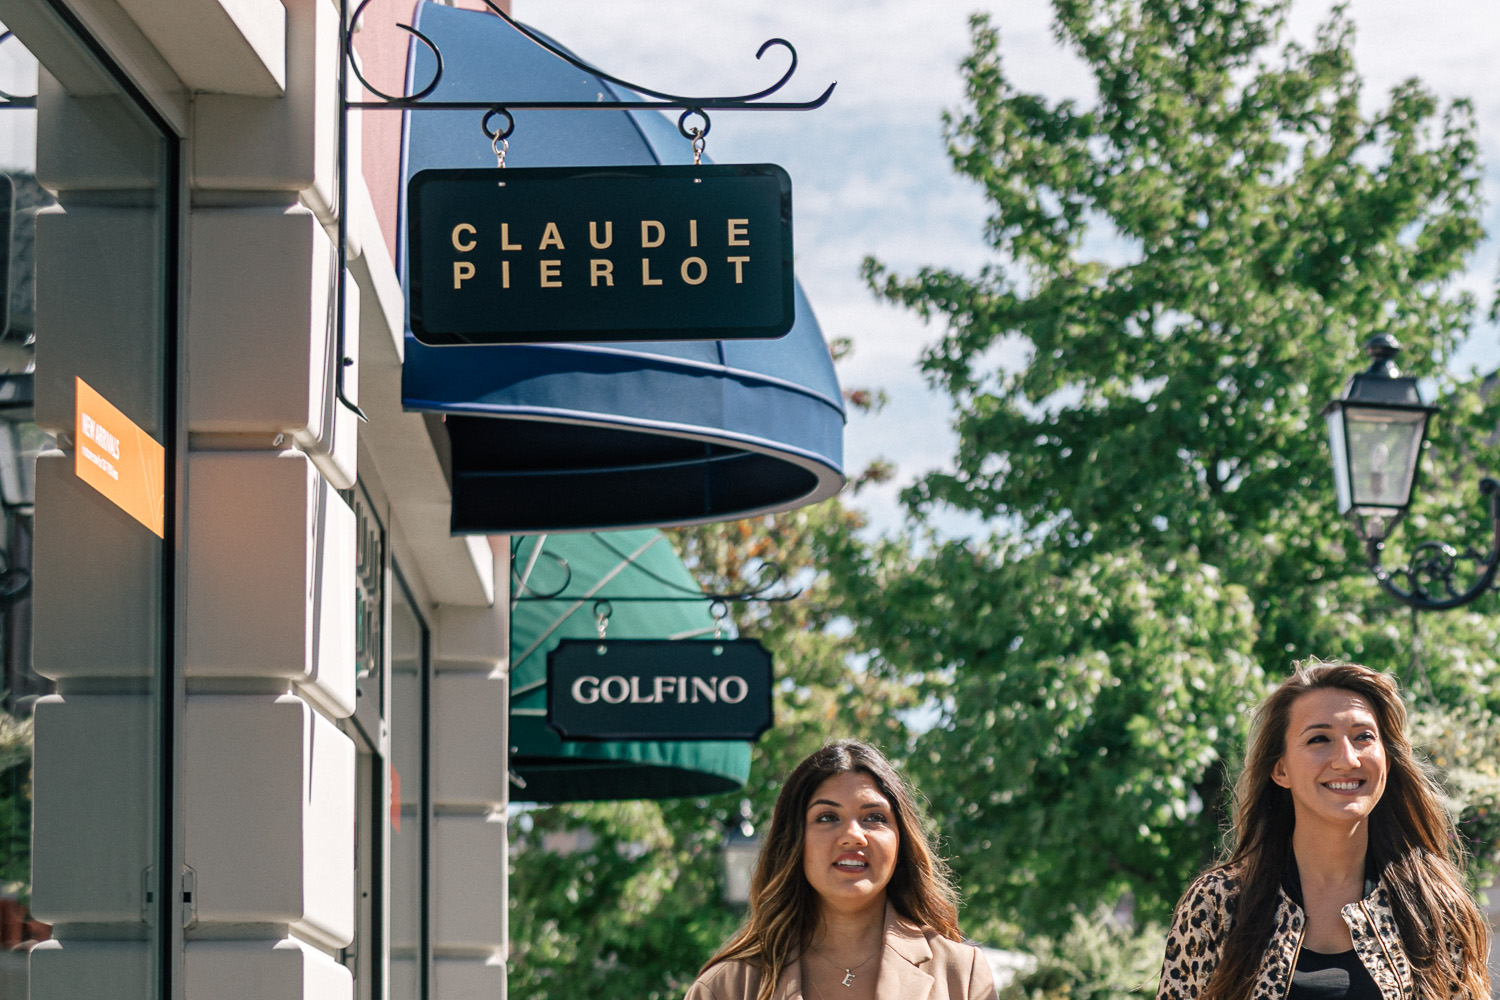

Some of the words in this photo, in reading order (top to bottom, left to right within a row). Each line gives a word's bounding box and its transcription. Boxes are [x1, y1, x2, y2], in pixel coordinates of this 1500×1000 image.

[452, 218, 750, 252] CLAUDIE
[453, 256, 750, 290] PIERLOT
[571, 675, 749, 704] GOLFINO
